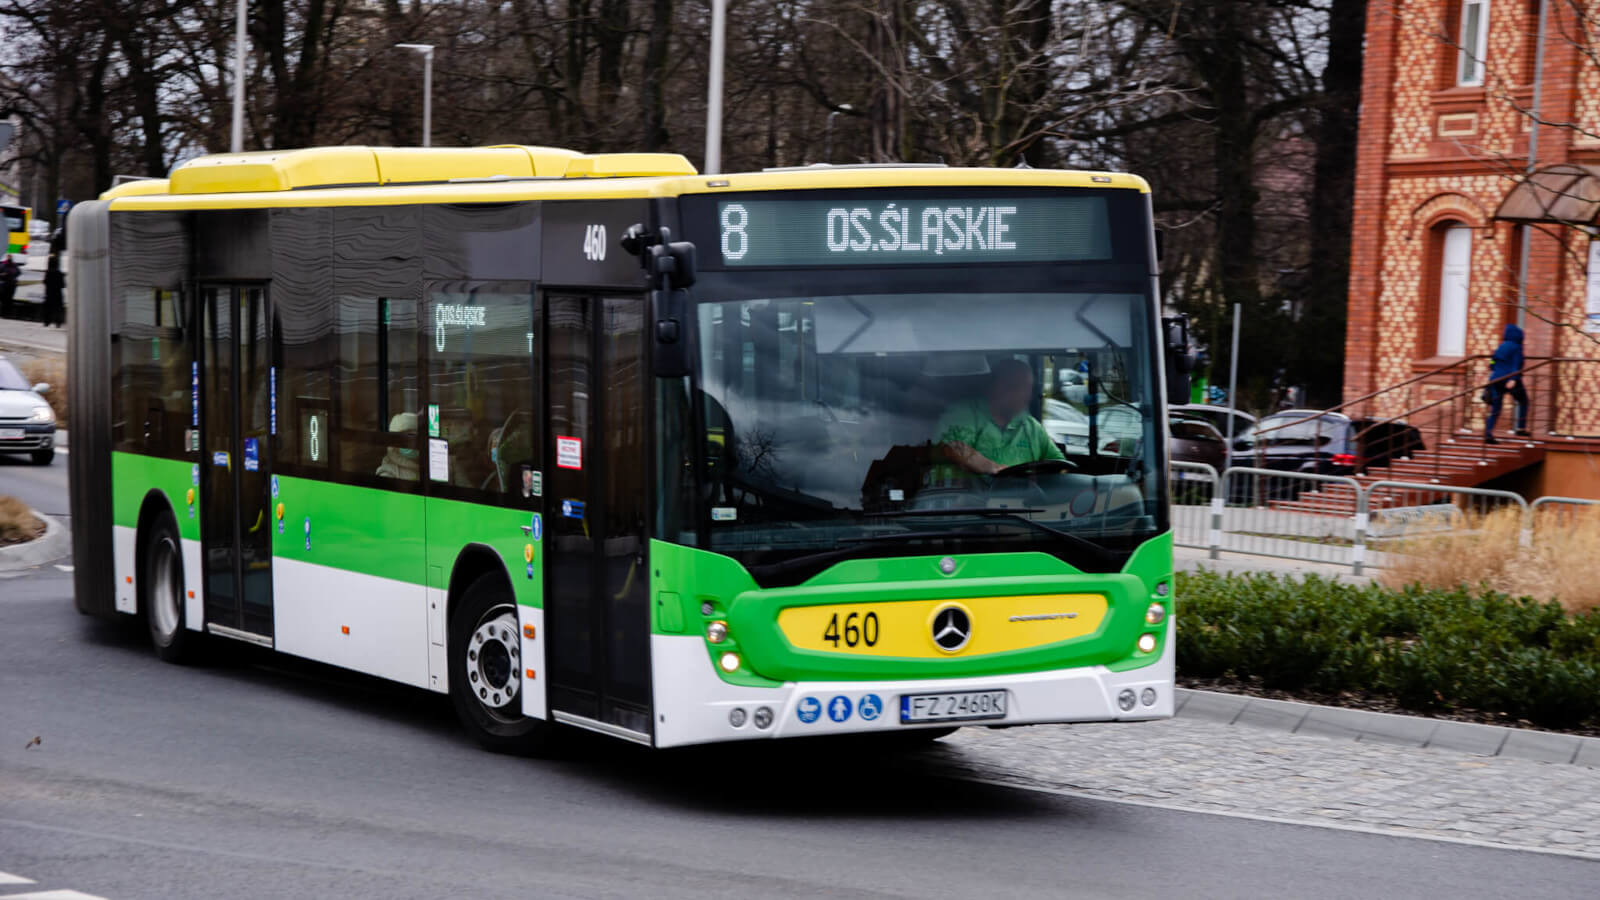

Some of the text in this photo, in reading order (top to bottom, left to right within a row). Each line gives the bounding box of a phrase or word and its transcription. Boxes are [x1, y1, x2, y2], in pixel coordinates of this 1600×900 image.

[583, 224, 607, 261] 460
[721, 203, 1017, 259] 8 OS.ŚLĄSKIE
[435, 303, 445, 353] 8
[310, 415, 319, 461] 8
[823, 611, 879, 648] 460
[913, 693, 1003, 717] FZ 2460K
